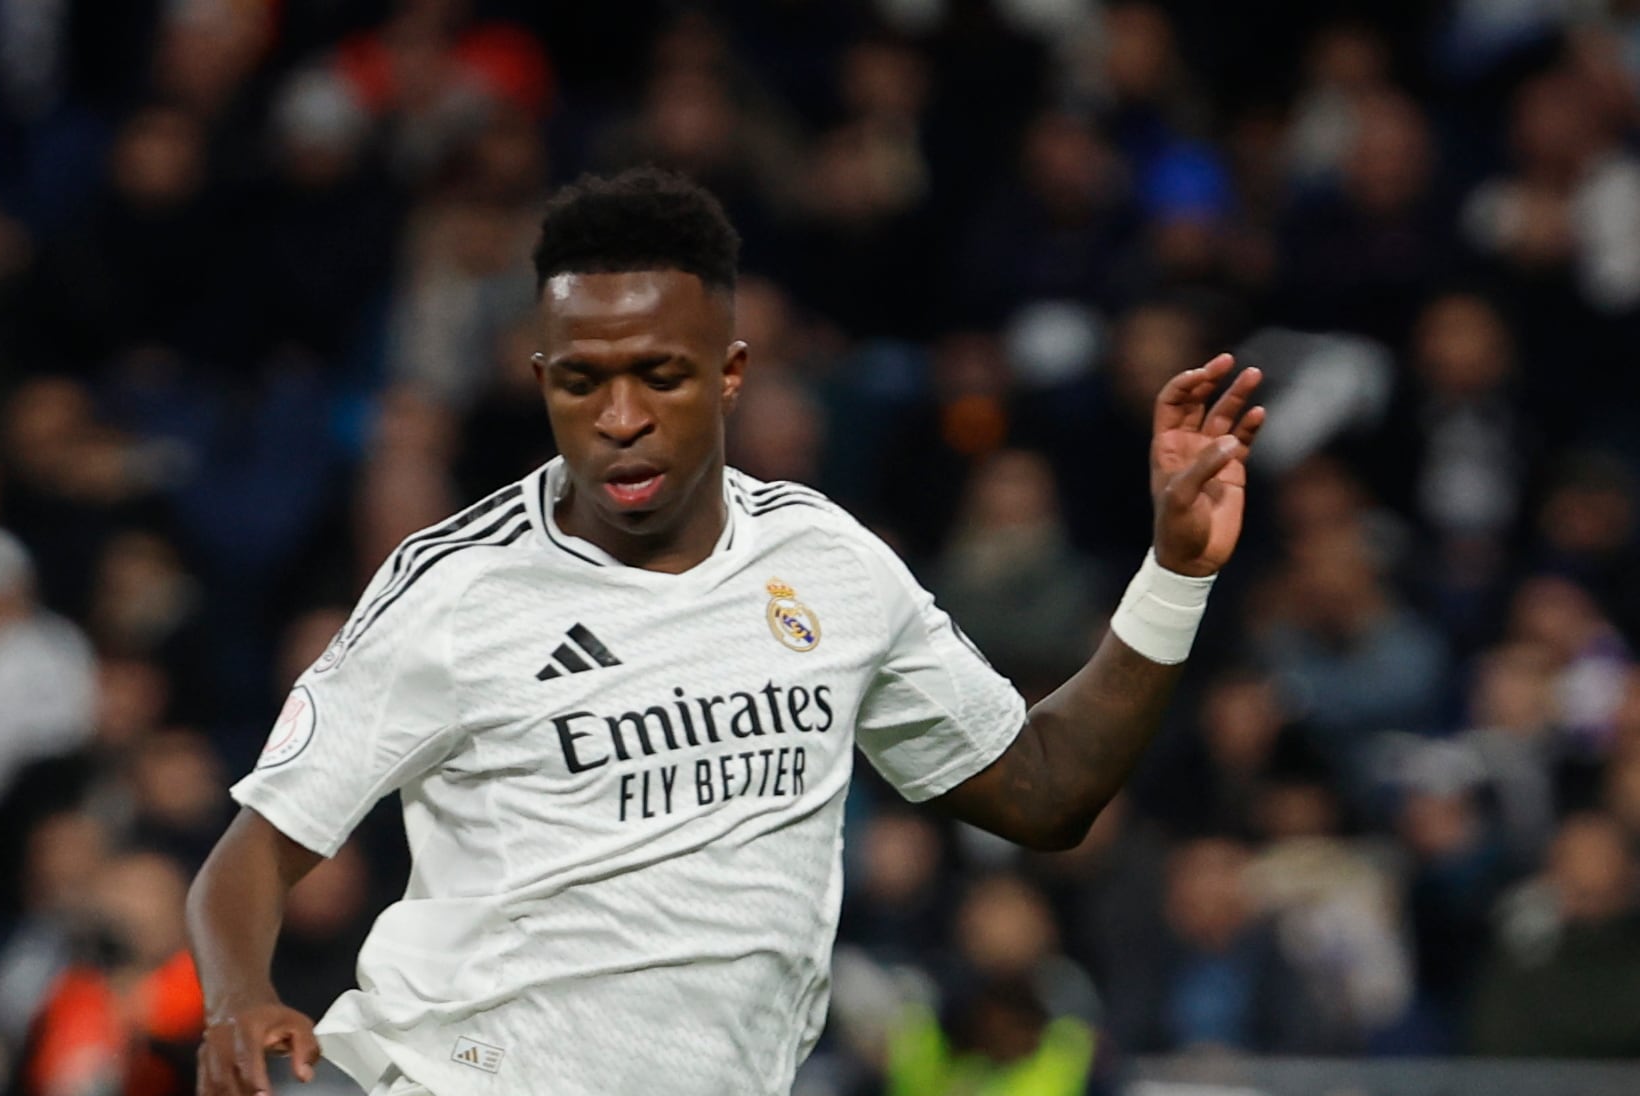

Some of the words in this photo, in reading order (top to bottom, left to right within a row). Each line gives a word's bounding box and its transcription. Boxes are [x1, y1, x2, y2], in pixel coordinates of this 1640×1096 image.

[551, 679, 834, 774] Emirates
[618, 764, 678, 822] FLY
[694, 746, 807, 807] BETTER
